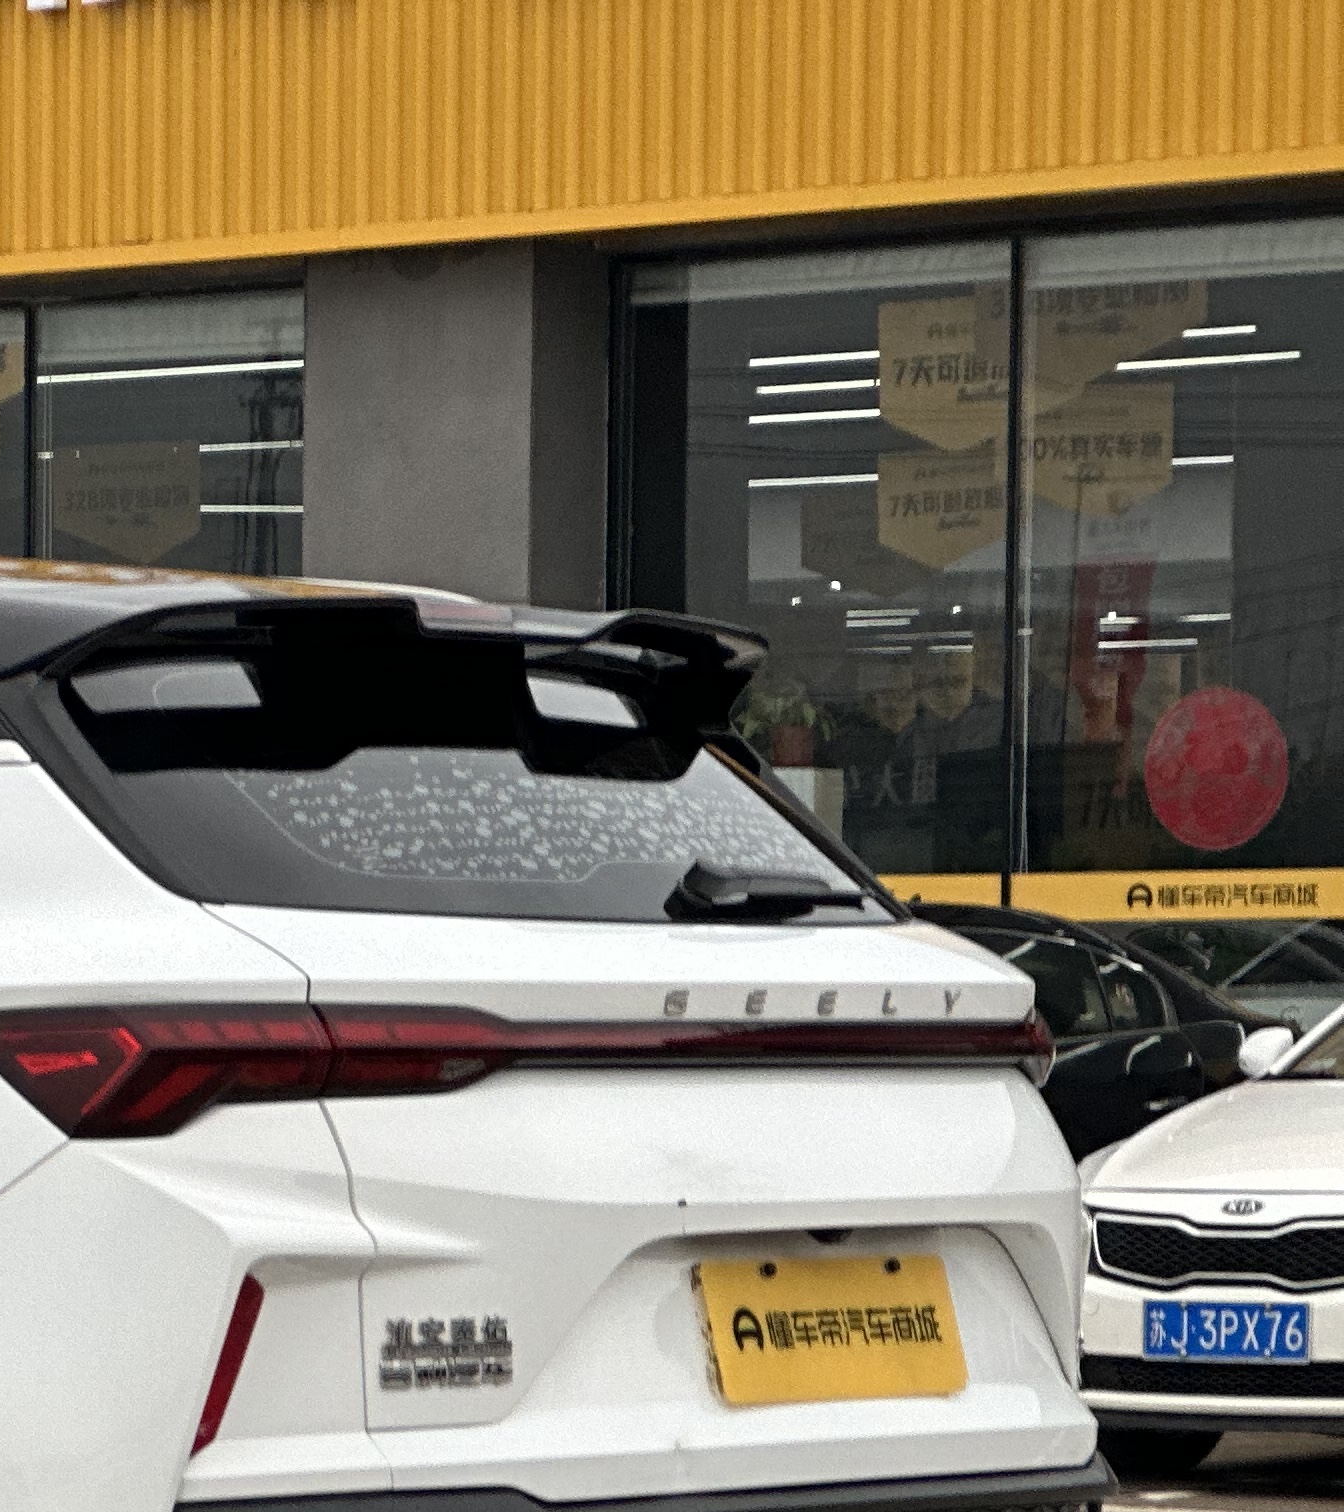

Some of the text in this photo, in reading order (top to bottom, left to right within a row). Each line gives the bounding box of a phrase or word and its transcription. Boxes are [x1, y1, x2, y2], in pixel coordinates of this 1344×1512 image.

[662, 988, 963, 1017] GEELY
[765, 1304, 943, 1351] 懂车帝汽车商城
